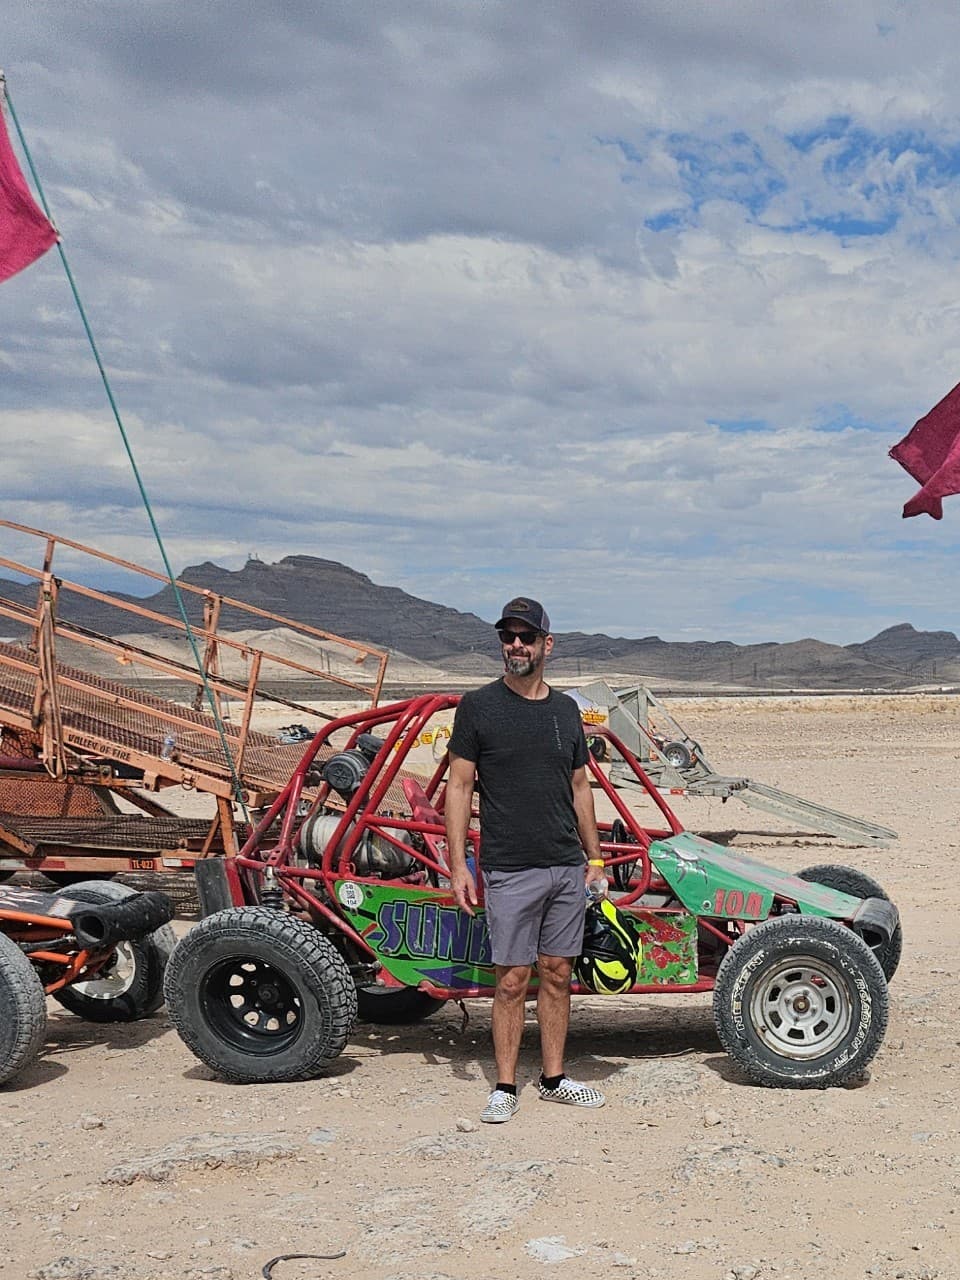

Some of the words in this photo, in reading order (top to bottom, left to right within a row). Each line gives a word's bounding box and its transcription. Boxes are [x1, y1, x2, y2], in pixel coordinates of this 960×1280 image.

[68, 734, 98, 749] VALLEY
[99, 745, 111, 754] OF
[112, 749, 130, 760] FIRE
[713, 888, 764, 918] 104
[731, 949, 766, 1032] NEXEN
[851, 978, 871, 1050] ROADIAN
